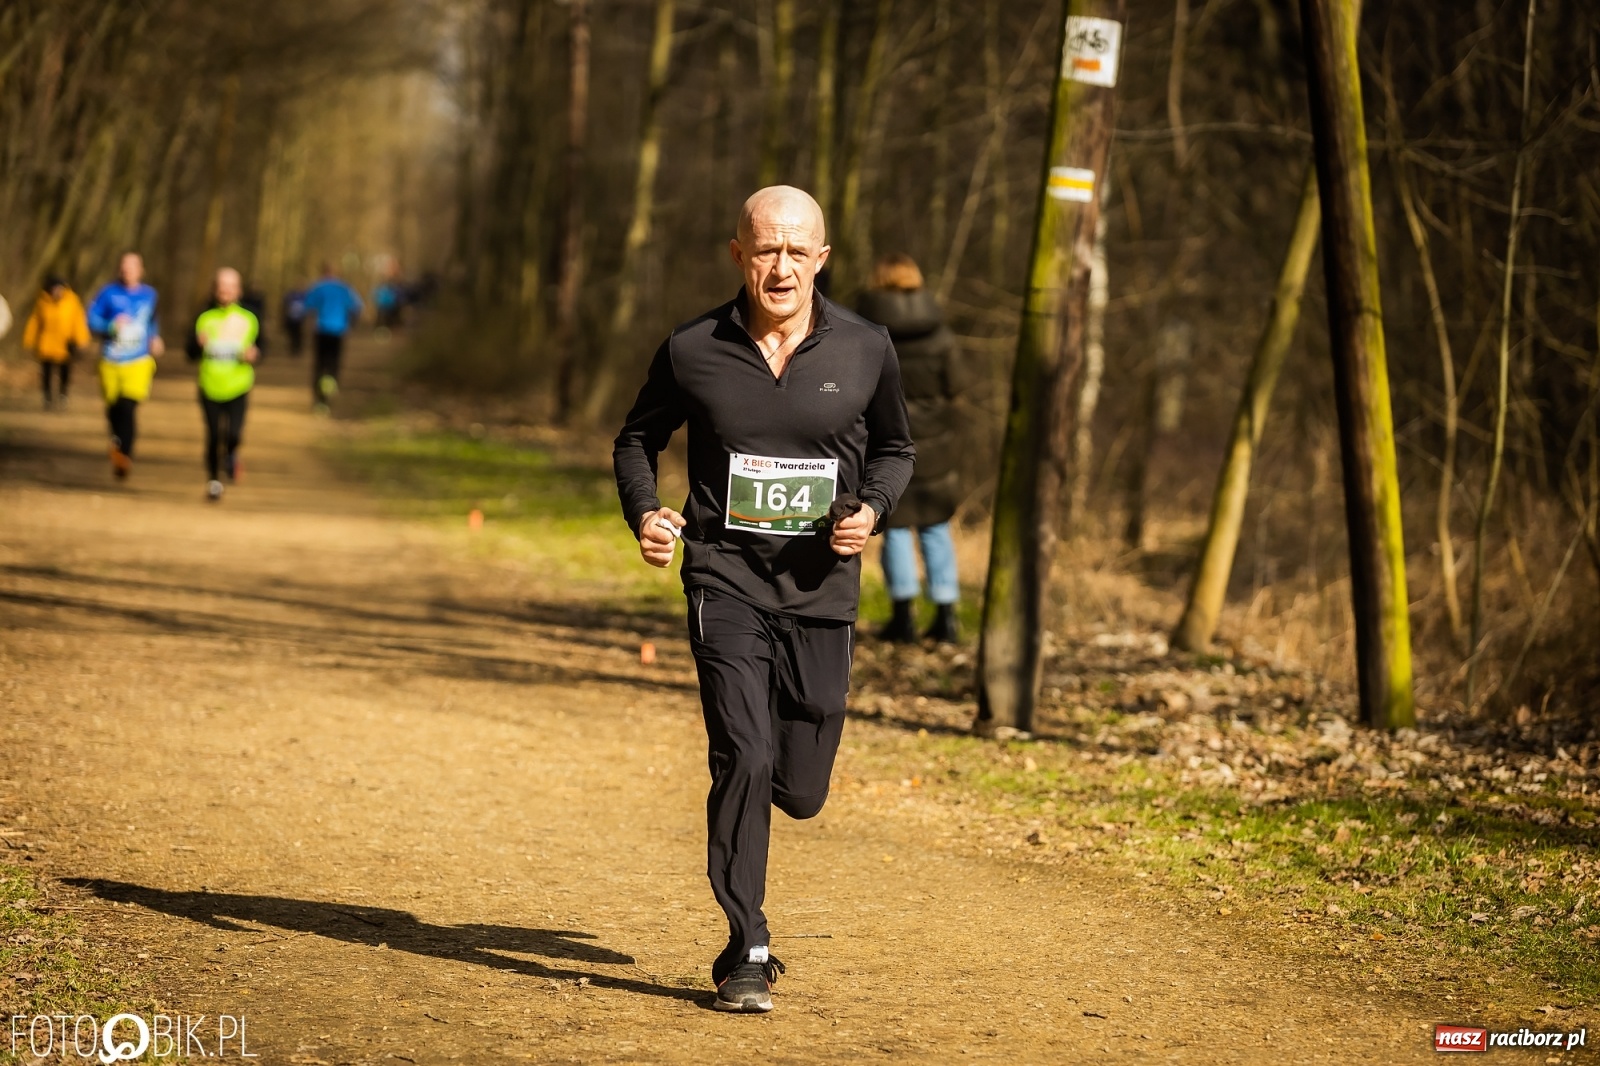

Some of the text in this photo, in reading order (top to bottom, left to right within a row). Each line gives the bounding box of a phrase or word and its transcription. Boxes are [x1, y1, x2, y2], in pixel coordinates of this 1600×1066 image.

[743, 457, 826, 471] X BIEG Twardziela
[753, 482, 812, 512] 164
